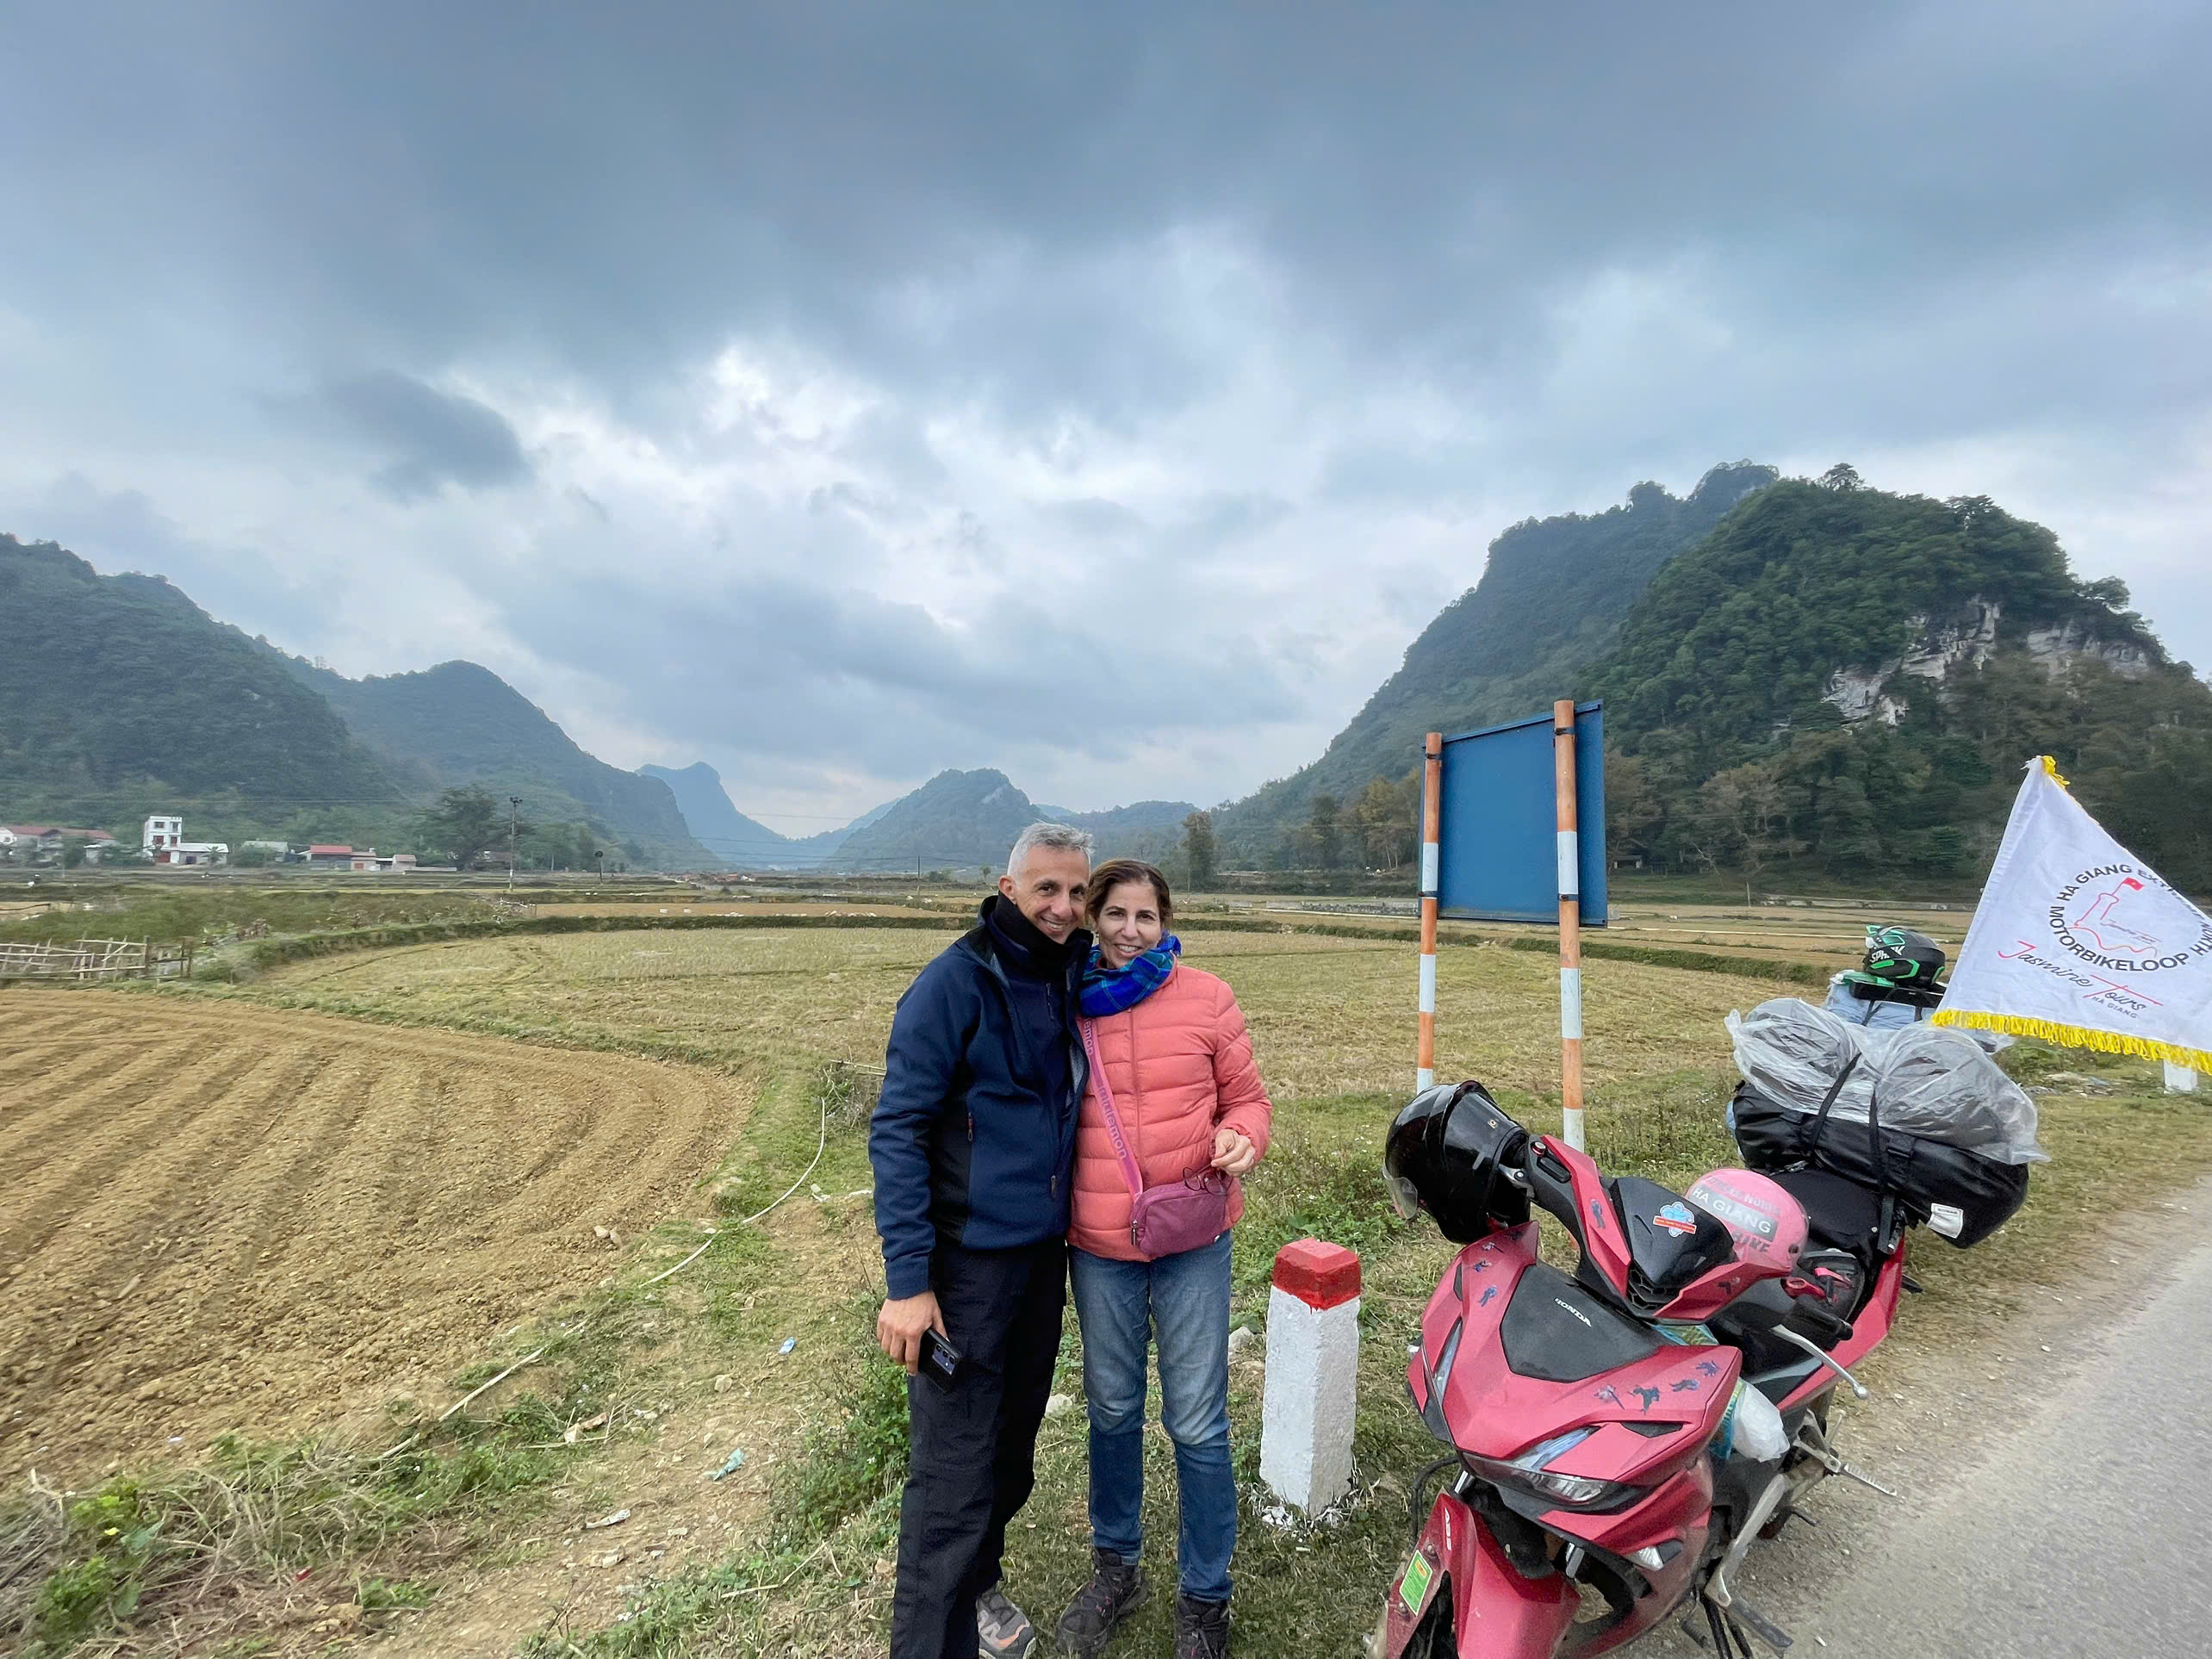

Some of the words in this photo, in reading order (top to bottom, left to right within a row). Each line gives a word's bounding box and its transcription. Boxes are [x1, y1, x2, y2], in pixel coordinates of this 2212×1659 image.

[2057, 885, 2079, 901] HA
[2075, 865, 2132, 884] GIANG
[2049, 906, 2190, 972] MOTORBIKELOOP
[1998, 940, 2094, 986] Jasmine
[2082, 974, 2164, 1010] Tours
[2107, 1003, 2138, 1019] GIANG
[1693, 1187, 1709, 1203] HA
[1712, 1199, 1772, 1233] GIANG
[1554, 1297, 1592, 1327] HONDA
